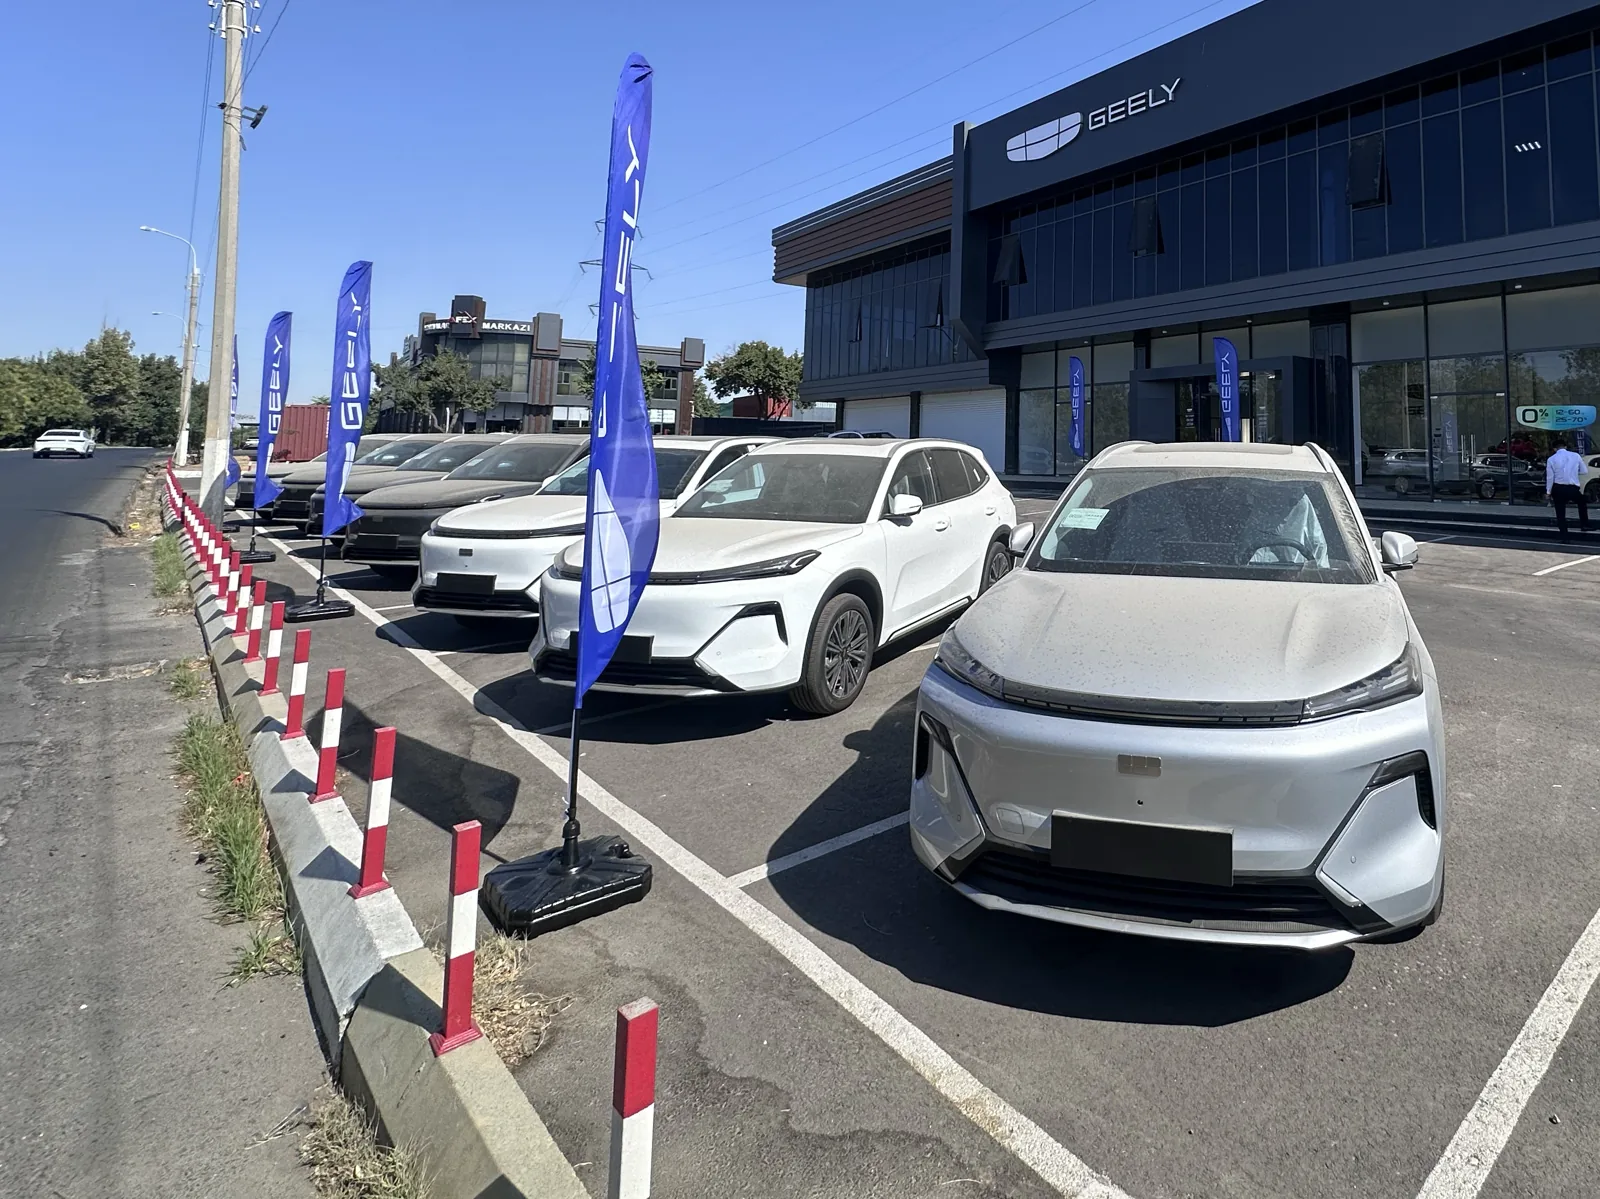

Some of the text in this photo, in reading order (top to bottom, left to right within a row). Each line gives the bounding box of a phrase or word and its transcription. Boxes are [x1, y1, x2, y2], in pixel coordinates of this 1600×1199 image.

[1088, 77, 1181, 131] GEELY
[481, 321, 531, 332] MARKAZI
[268, 334, 283, 435] GEELY
